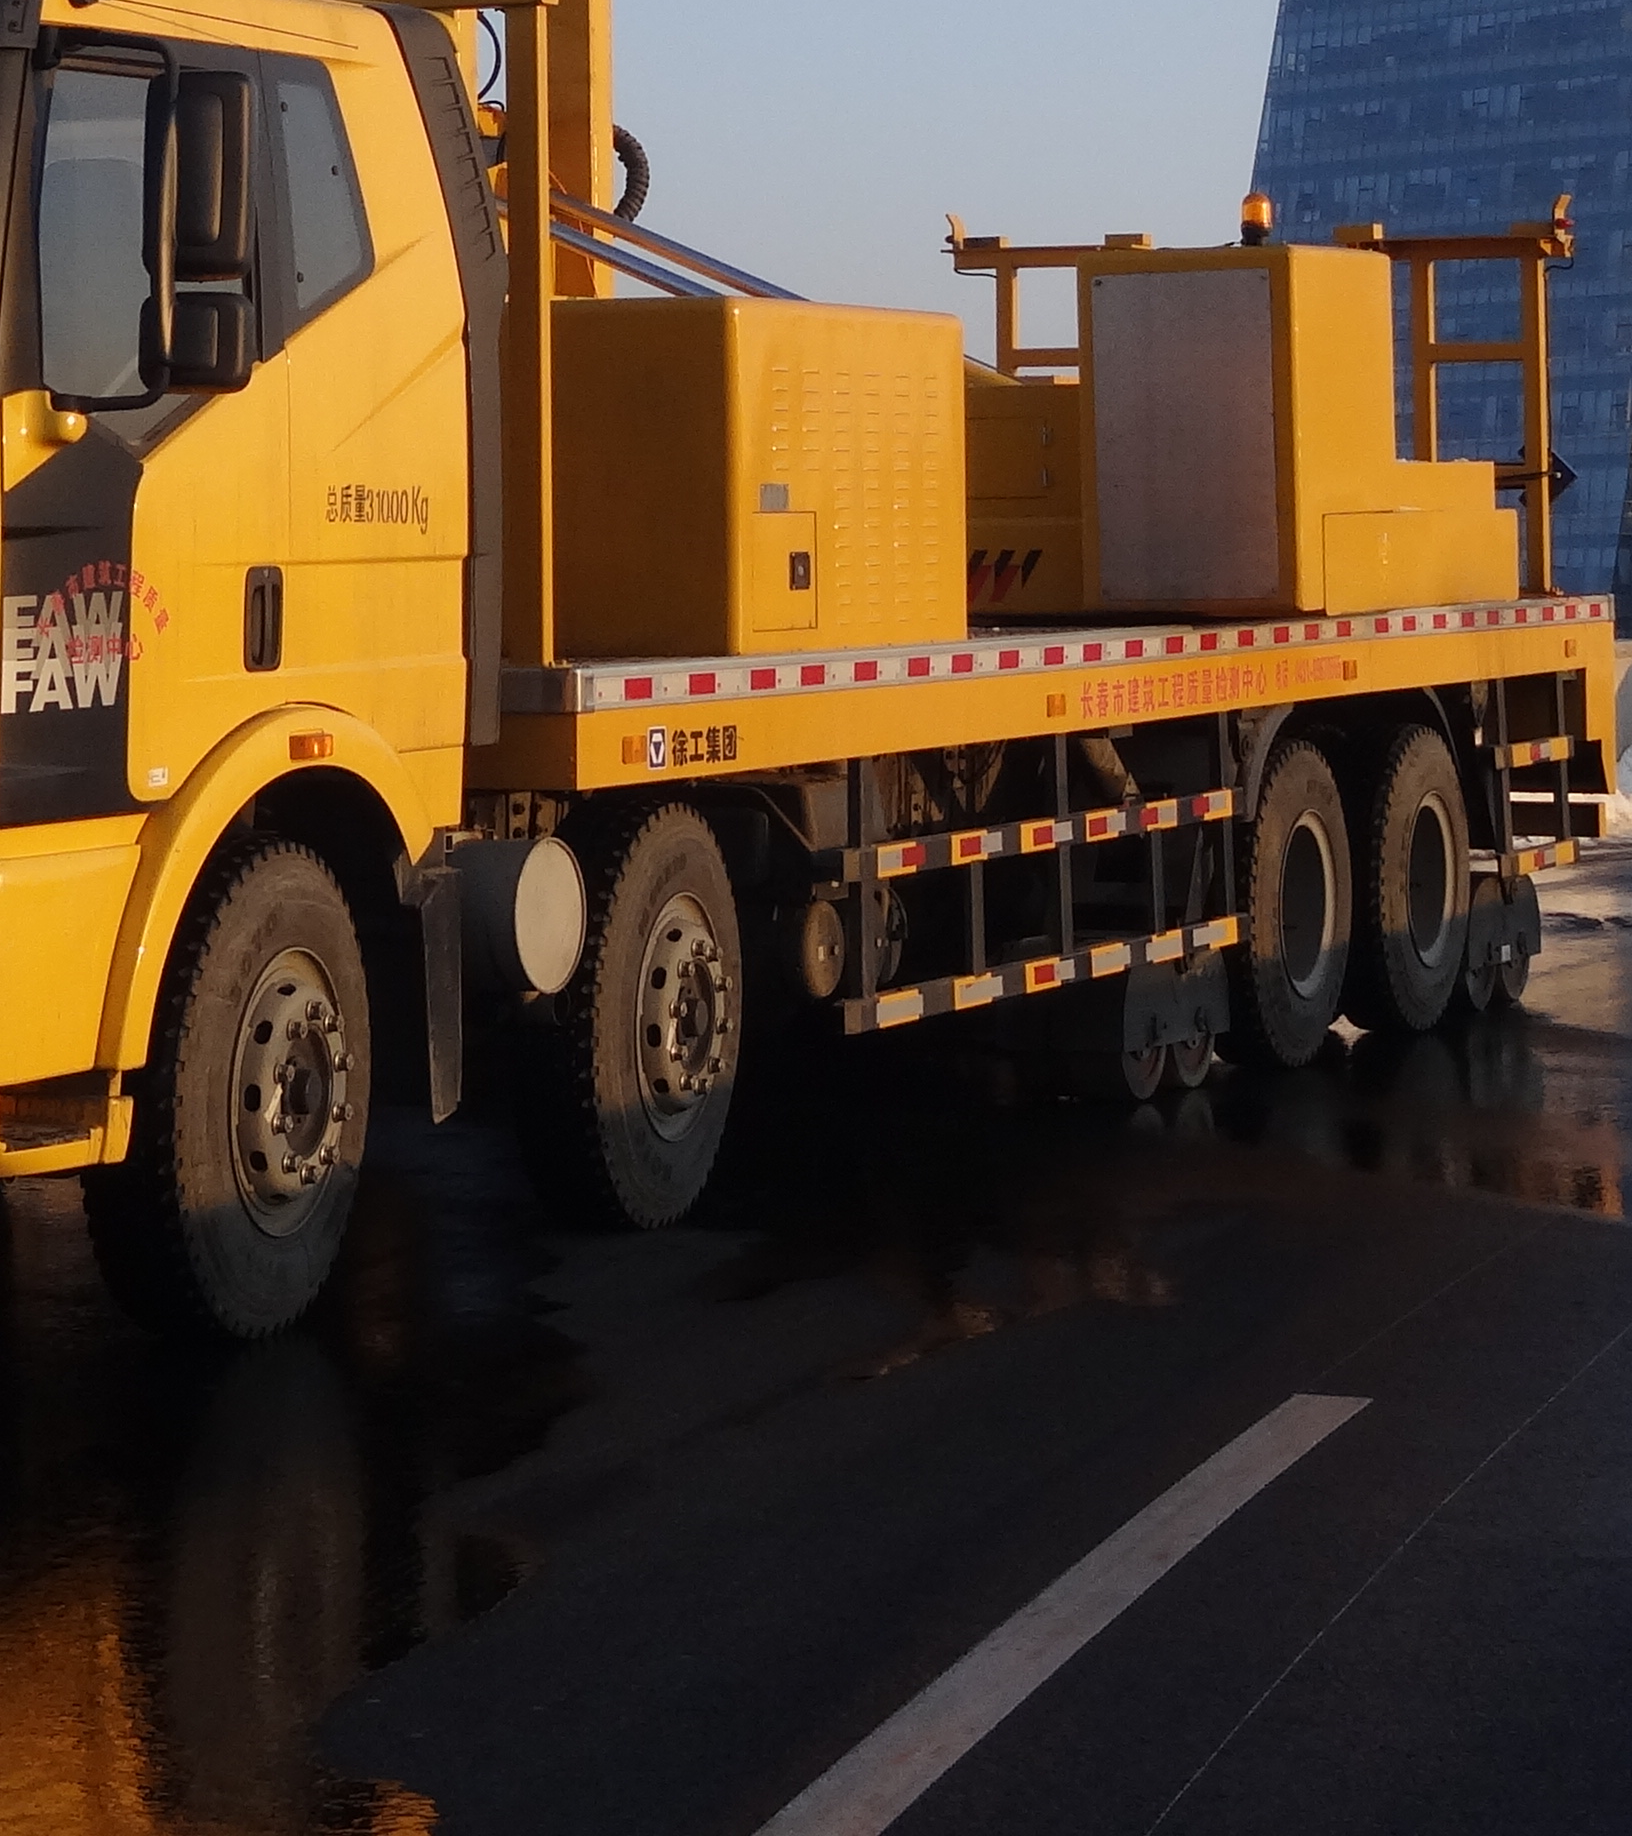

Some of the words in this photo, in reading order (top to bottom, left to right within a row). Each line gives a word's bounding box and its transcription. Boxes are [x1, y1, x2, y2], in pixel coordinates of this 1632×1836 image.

[66, 632, 144, 663] 检测中心
[0, 654, 124, 714] FAW
[1081, 663, 1267, 719] 长春市建筑工程质量检测中心
[672, 725, 737, 767] 徐工集团
